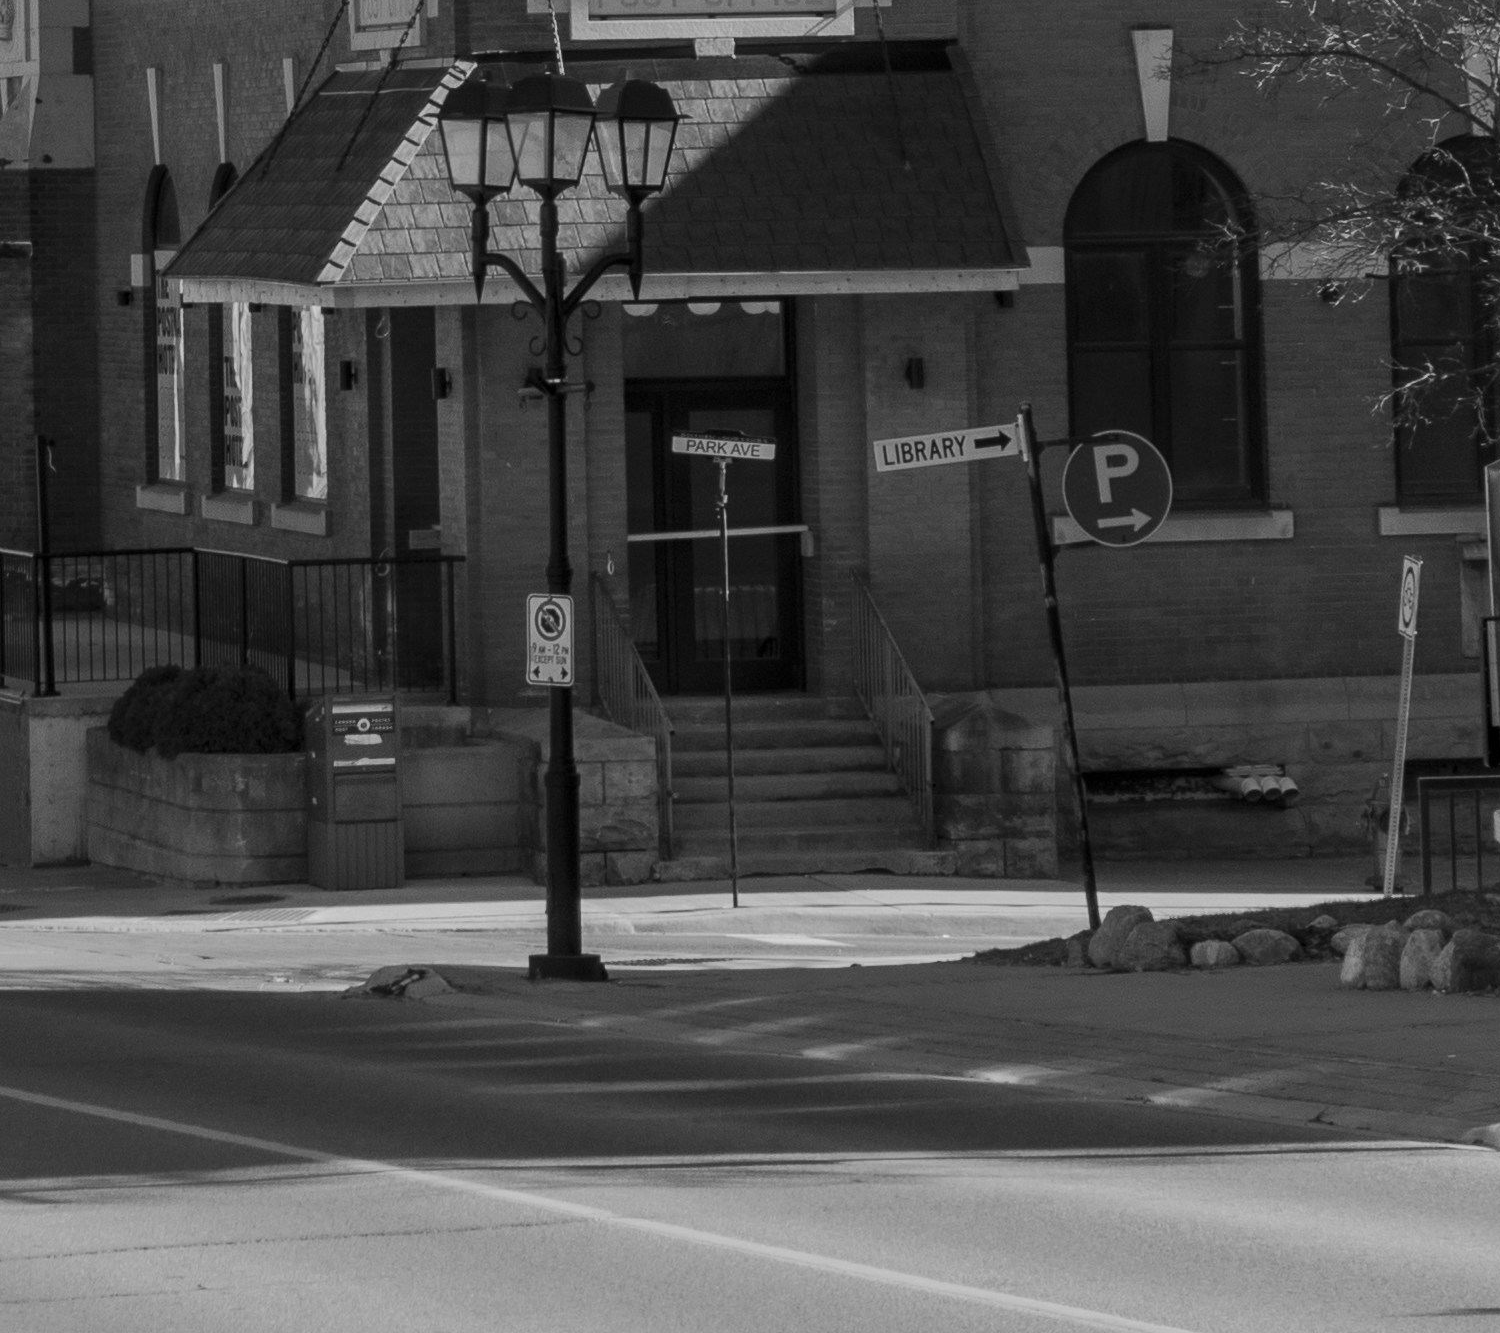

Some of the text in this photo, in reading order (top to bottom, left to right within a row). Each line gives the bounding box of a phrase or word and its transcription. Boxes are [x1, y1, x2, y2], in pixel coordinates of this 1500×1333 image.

[686, 439, 761, 457] PARK AVE
[883, 436, 965, 466] LIBRARY
[1093, 443, 1140, 504] P
[532, 642, 537, 653] 9
[553, 643, 560, 655] 12
